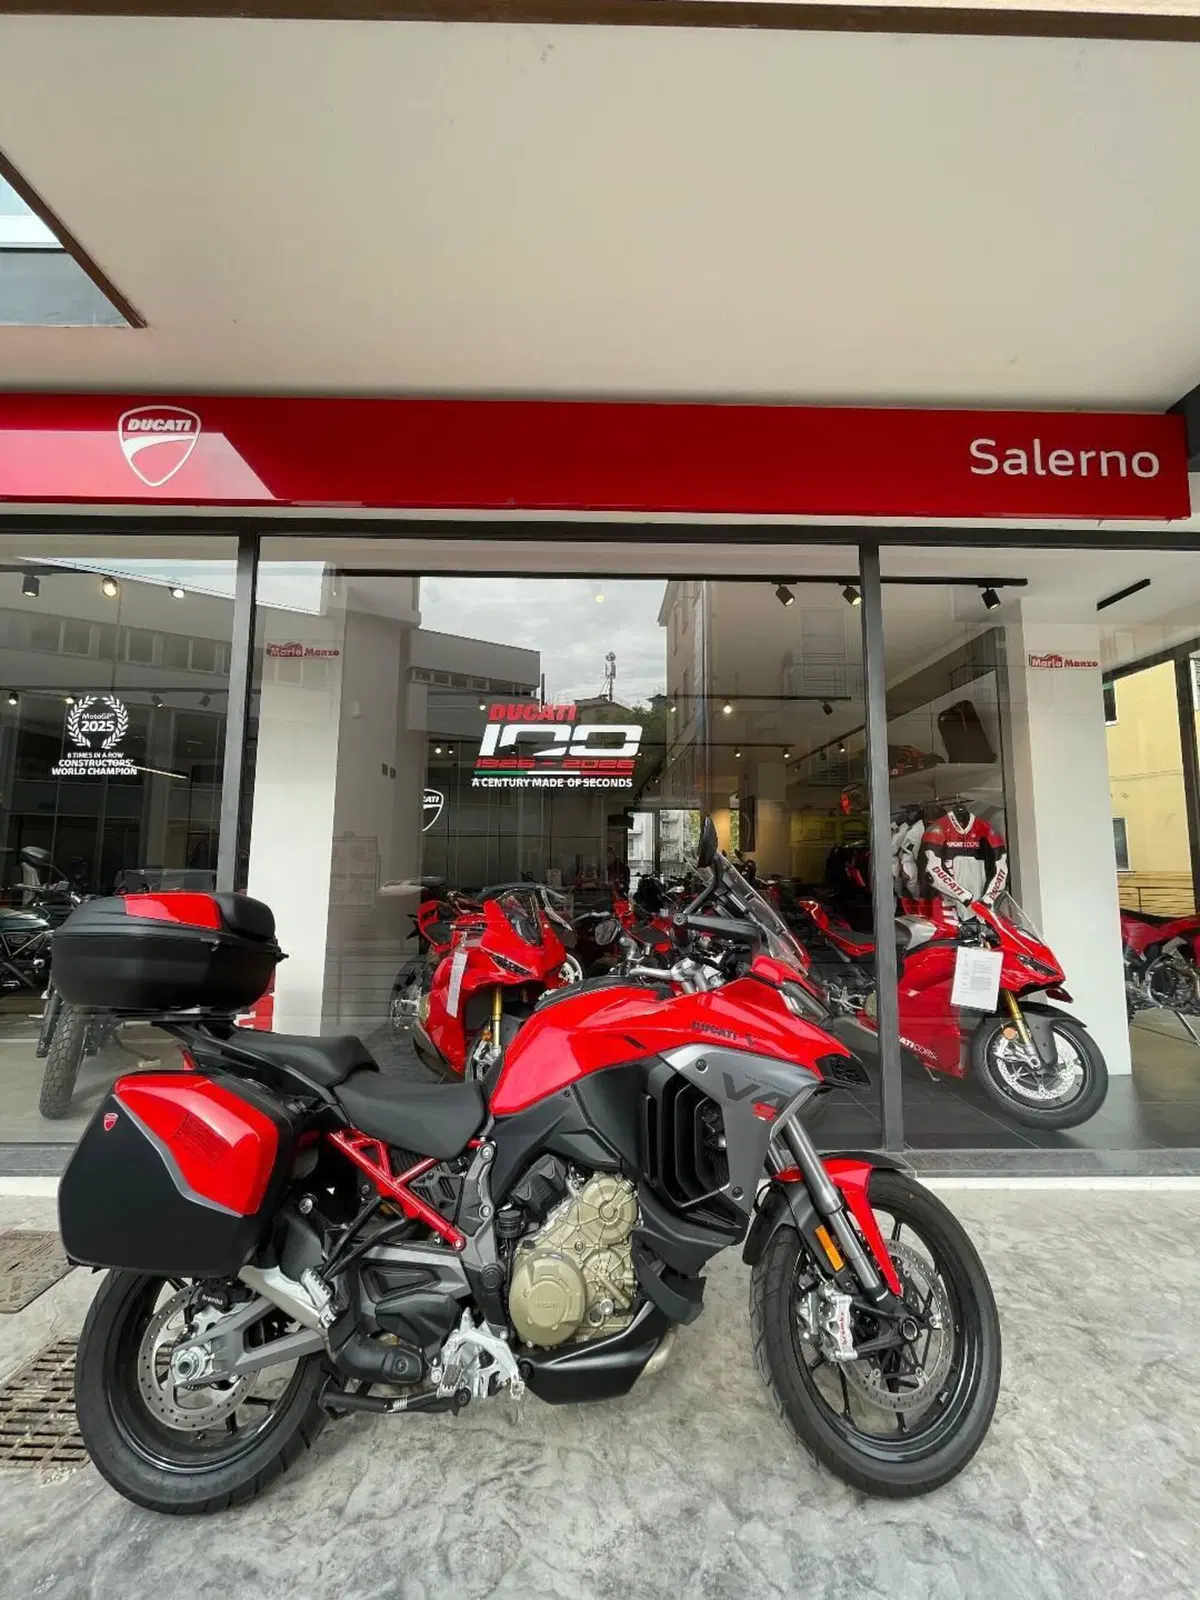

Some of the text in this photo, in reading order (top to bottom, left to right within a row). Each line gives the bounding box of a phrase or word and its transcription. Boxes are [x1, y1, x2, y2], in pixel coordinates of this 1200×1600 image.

[127, 418, 192, 431] DUCATI
[969, 438, 1160, 478] Salerno
[304, 647, 339, 656] Manzo
[1064, 659, 1098, 668] Manzo
[488, 703, 577, 721] DUCATI
[80, 720, 115, 732] 2025
[478, 724, 643, 757] 100
[51, 767, 138, 776] WORLD CHAMPION
[475, 759, 536, 769] 1926
[561, 759, 636, 769] 2026
[471, 778, 633, 788] A CENTURY MADE OF SECONDS
[932, 866, 965, 896] DUCATI
[989, 869, 1006, 900] DUCATI
[692, 1020, 738, 1041] DUCATI
[752, 1101, 778, 1122] S
